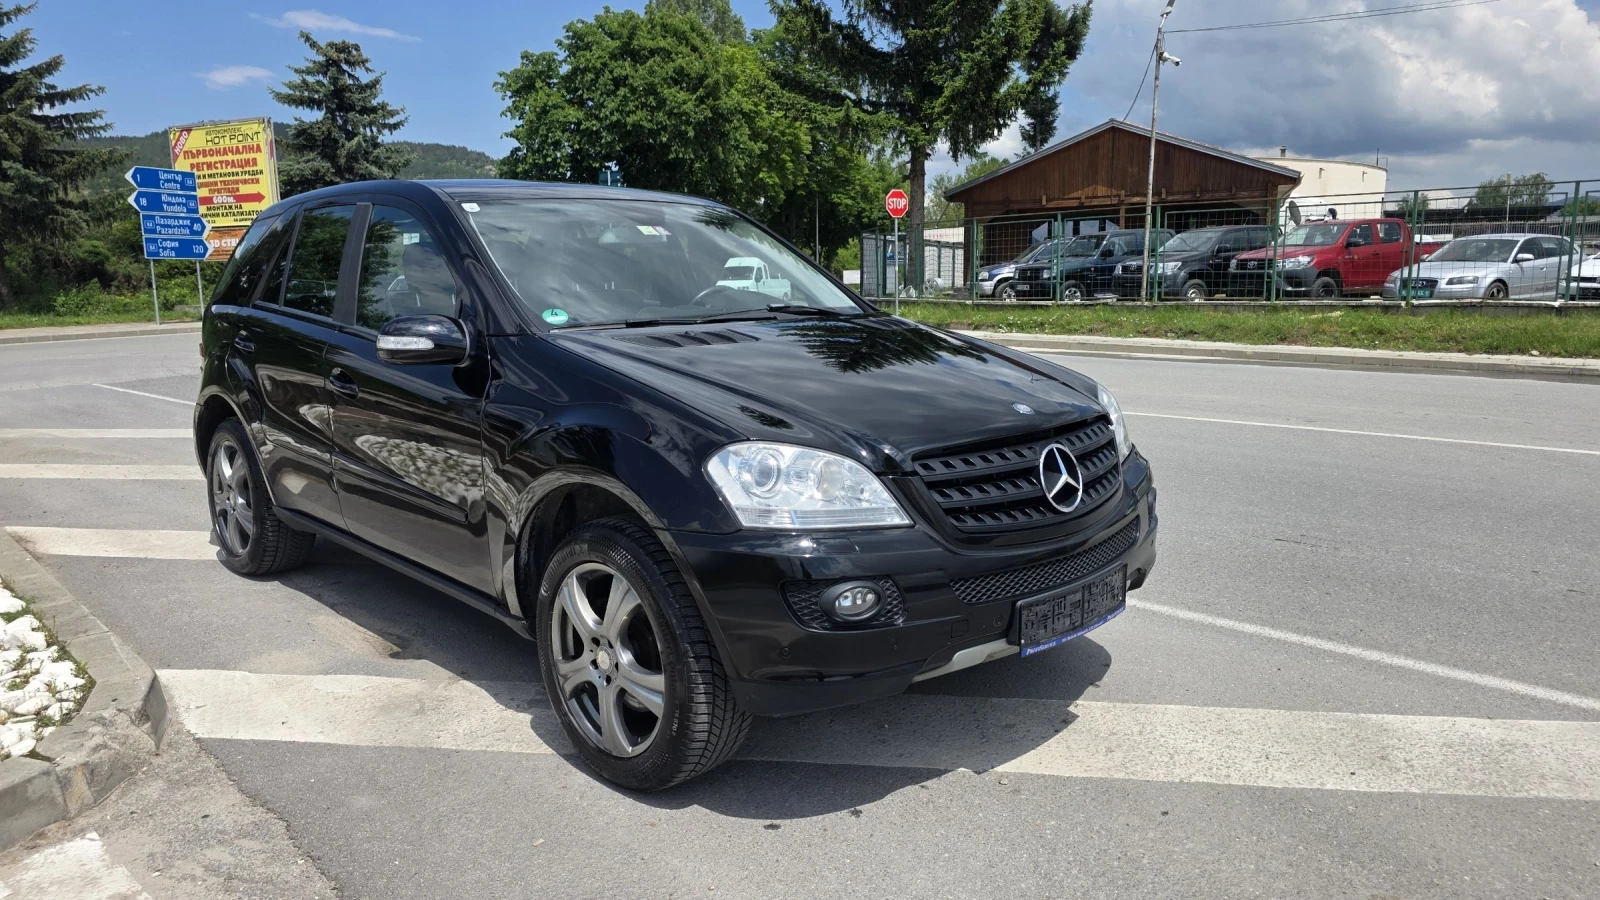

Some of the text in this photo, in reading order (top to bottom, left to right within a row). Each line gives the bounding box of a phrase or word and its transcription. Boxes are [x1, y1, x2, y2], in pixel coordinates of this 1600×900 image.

[174, 131, 188, 155] НОВО
[205, 131, 261, 146] HOT POINT
[183, 143, 262, 160] ПЪРВОНАЧАЛНА
[190, 157, 258, 172] РЕГИСТРАЦИЯ
[136, 174, 140, 182] 1
[158, 171, 183, 182] Център
[207, 171, 240, 179] МЕТАНОВИ
[160, 181, 181, 190] Centre
[140, 197, 148, 206] 18
[161, 194, 186, 204] Юндола
[888, 197, 907, 210] STOP
[162, 203, 187, 213] Yundola
[206, 204, 234, 212] МОНТАЖ
[155, 216, 191, 227] Пазарджик
[156, 225, 190, 235] Pazardzhik
[193, 223, 202, 231] 40
[157, 239, 179, 248] София
[159, 248, 176, 257] Sofia
[192, 245, 204, 253] 120
